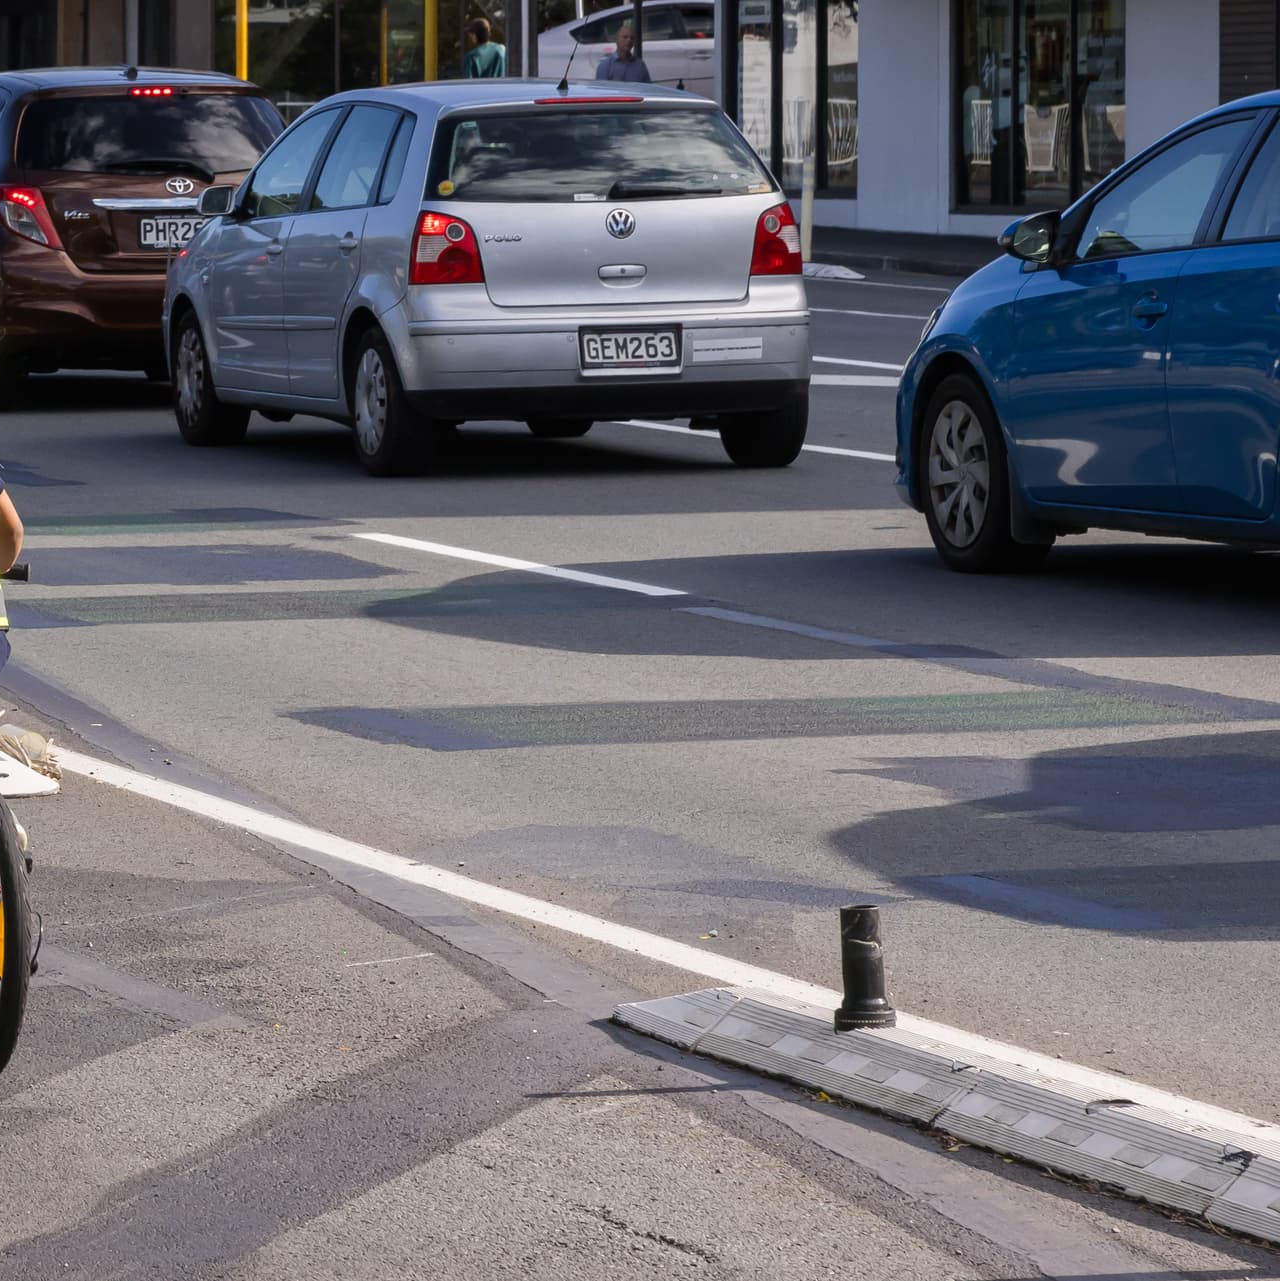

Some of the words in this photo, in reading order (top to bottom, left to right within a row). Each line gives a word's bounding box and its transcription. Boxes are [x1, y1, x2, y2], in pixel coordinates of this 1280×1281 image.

[142, 221, 203, 242] PHR26
[483, 232, 522, 243] POLO
[586, 335, 675, 361] GEM263
